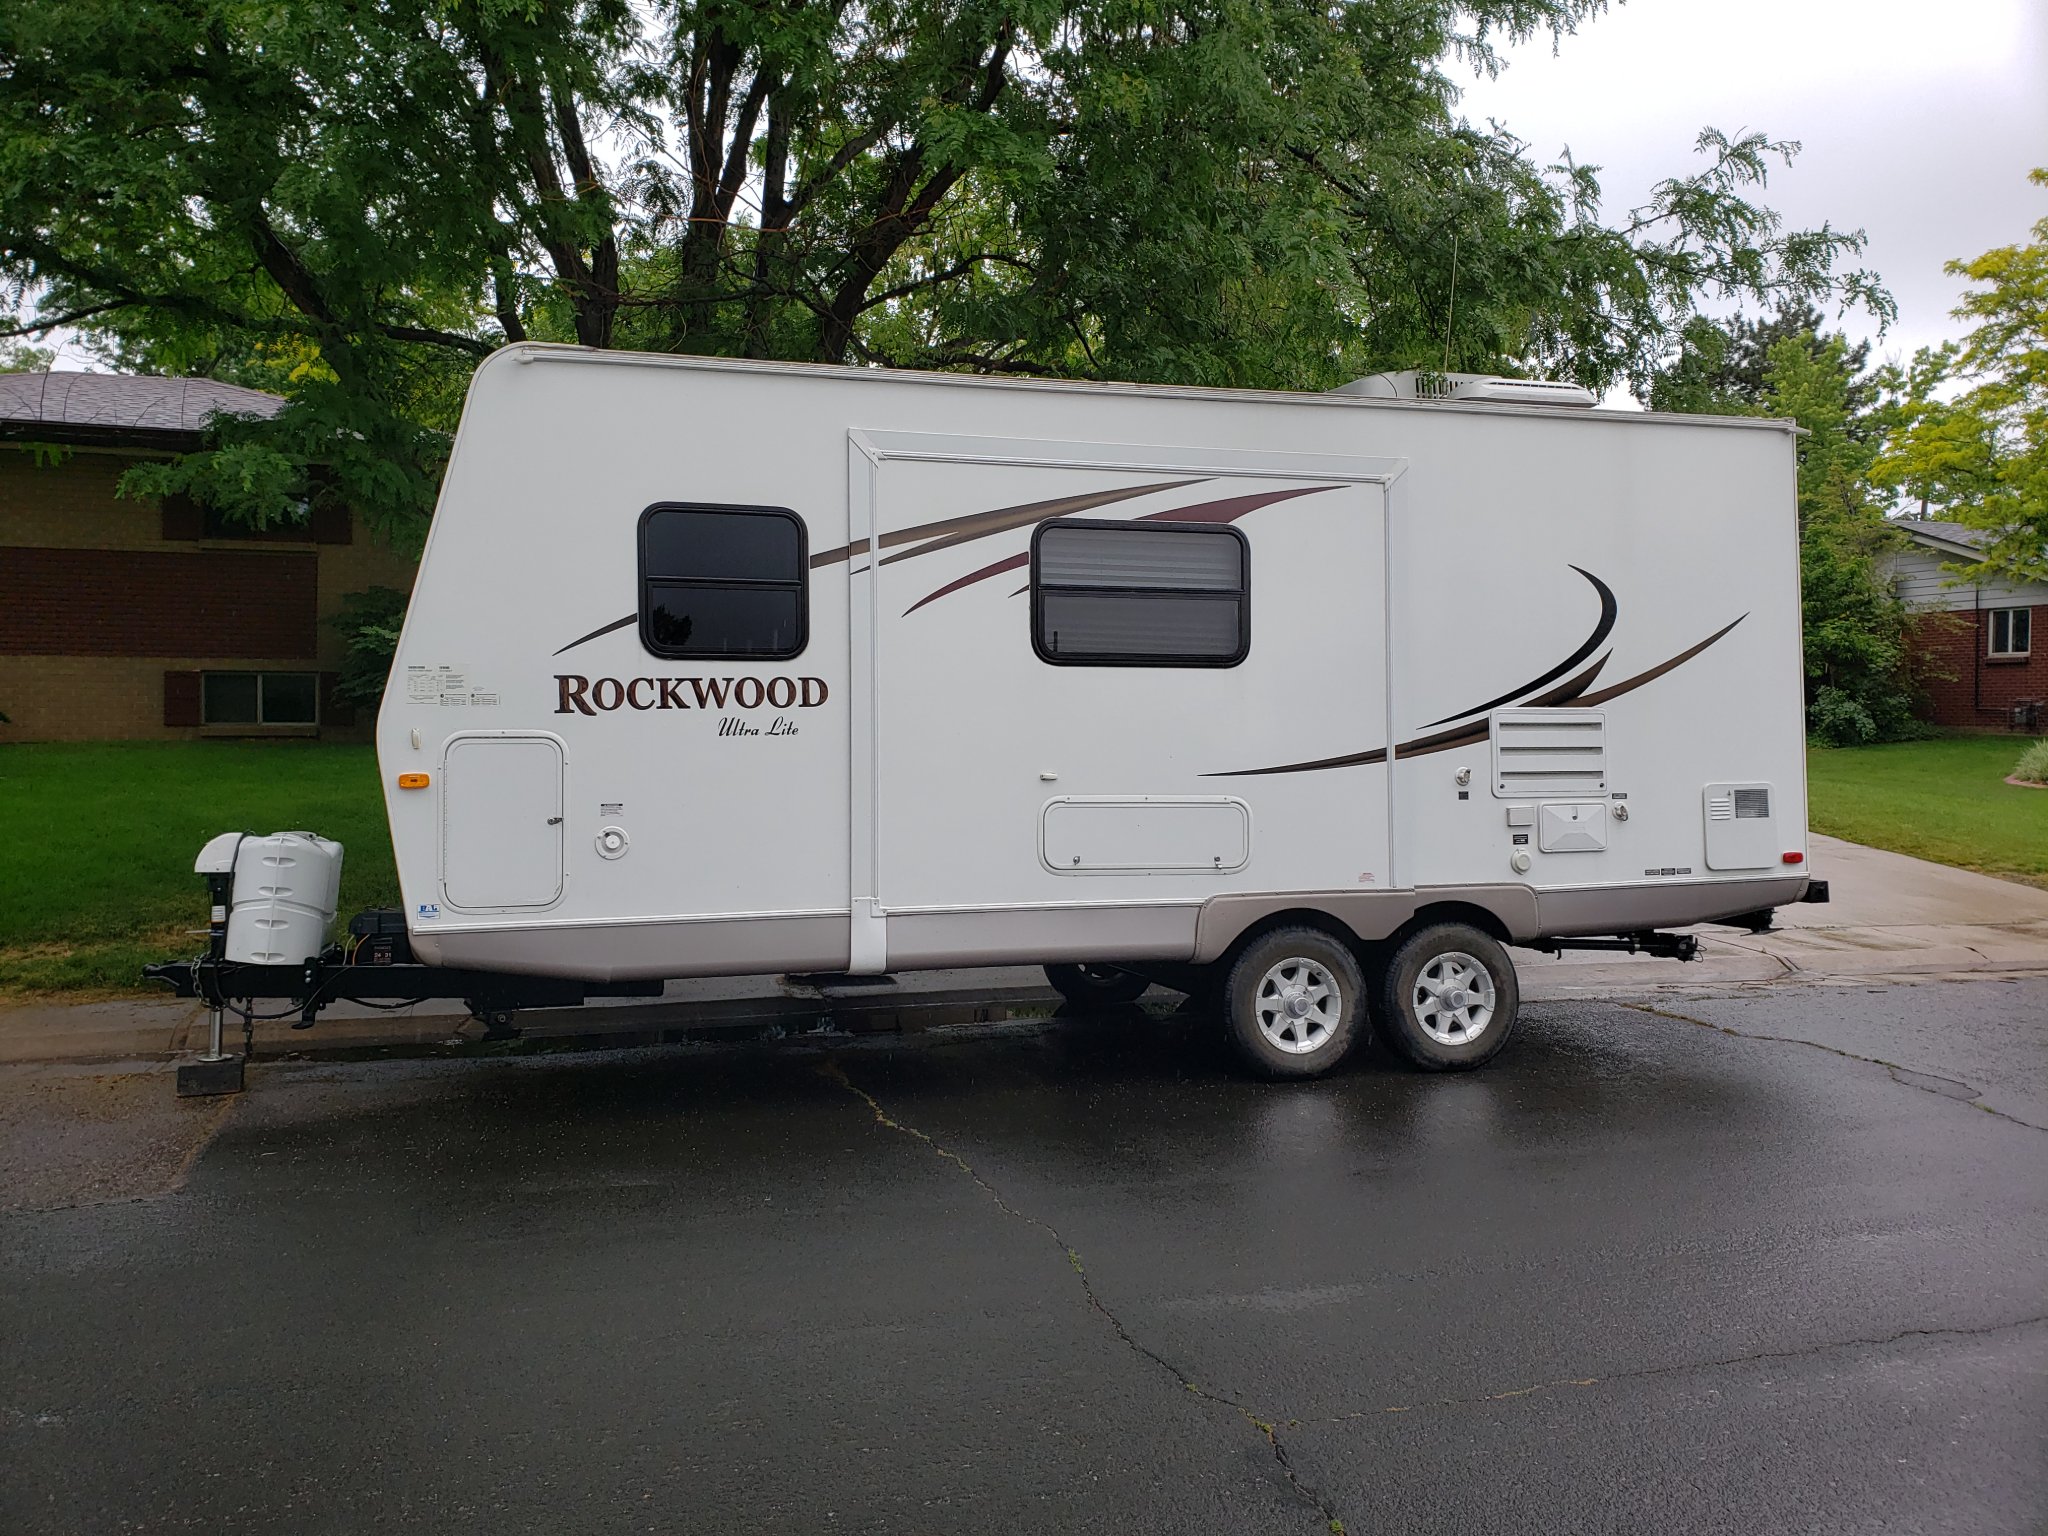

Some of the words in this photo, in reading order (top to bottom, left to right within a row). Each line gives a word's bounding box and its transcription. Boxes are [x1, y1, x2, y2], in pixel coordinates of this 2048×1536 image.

[553, 674, 829, 717] ROCKWOOD
[718, 716, 760, 737] Ultra
[764, 716, 799, 737] Lite
